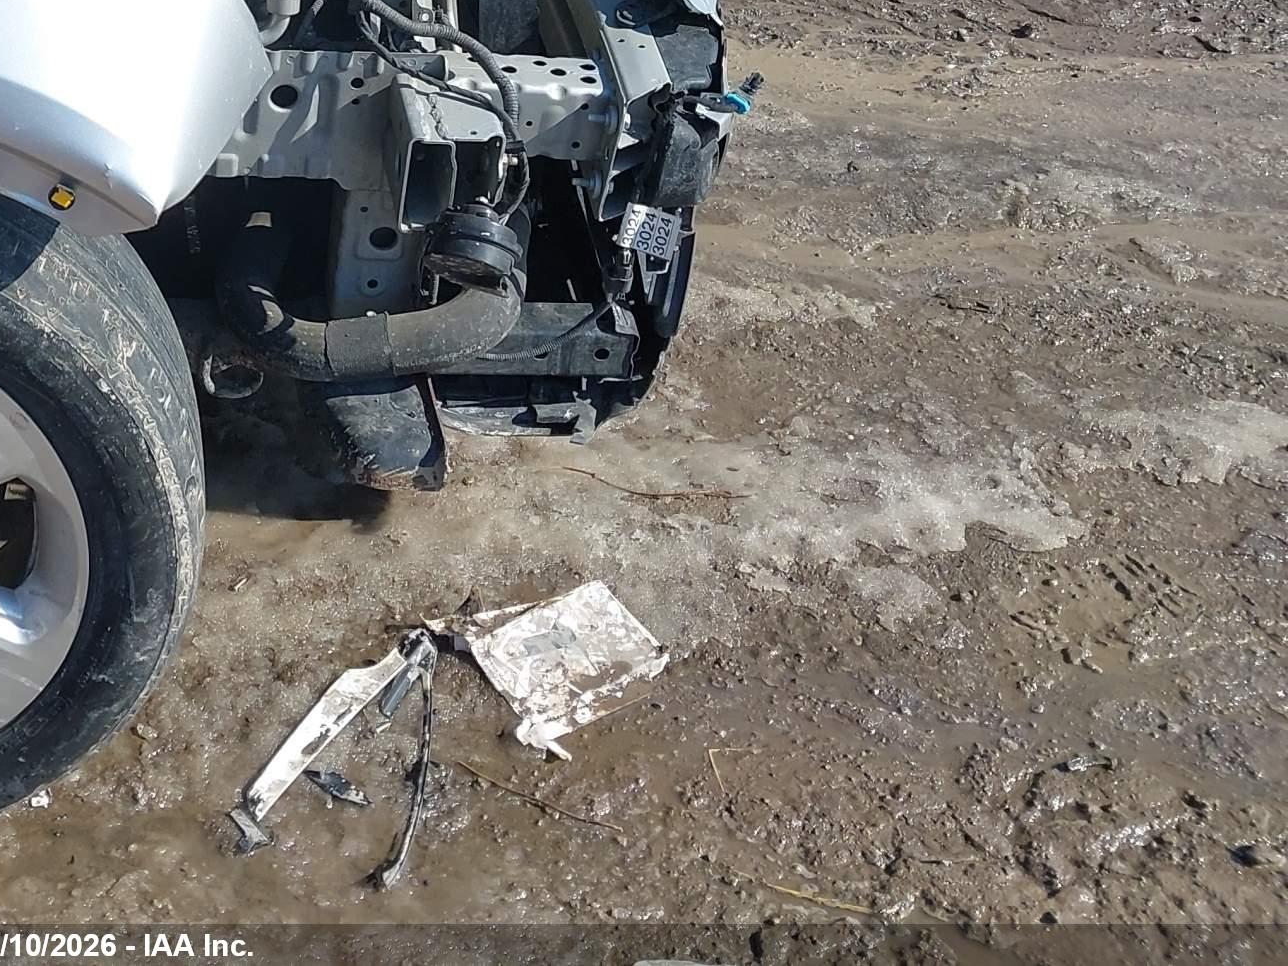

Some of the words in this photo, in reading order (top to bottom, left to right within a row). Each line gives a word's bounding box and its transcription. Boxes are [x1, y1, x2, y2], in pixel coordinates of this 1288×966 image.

[622, 208, 642, 245] 3024
[637, 212, 657, 250] 3024
[653, 218, 672, 255] 3024
